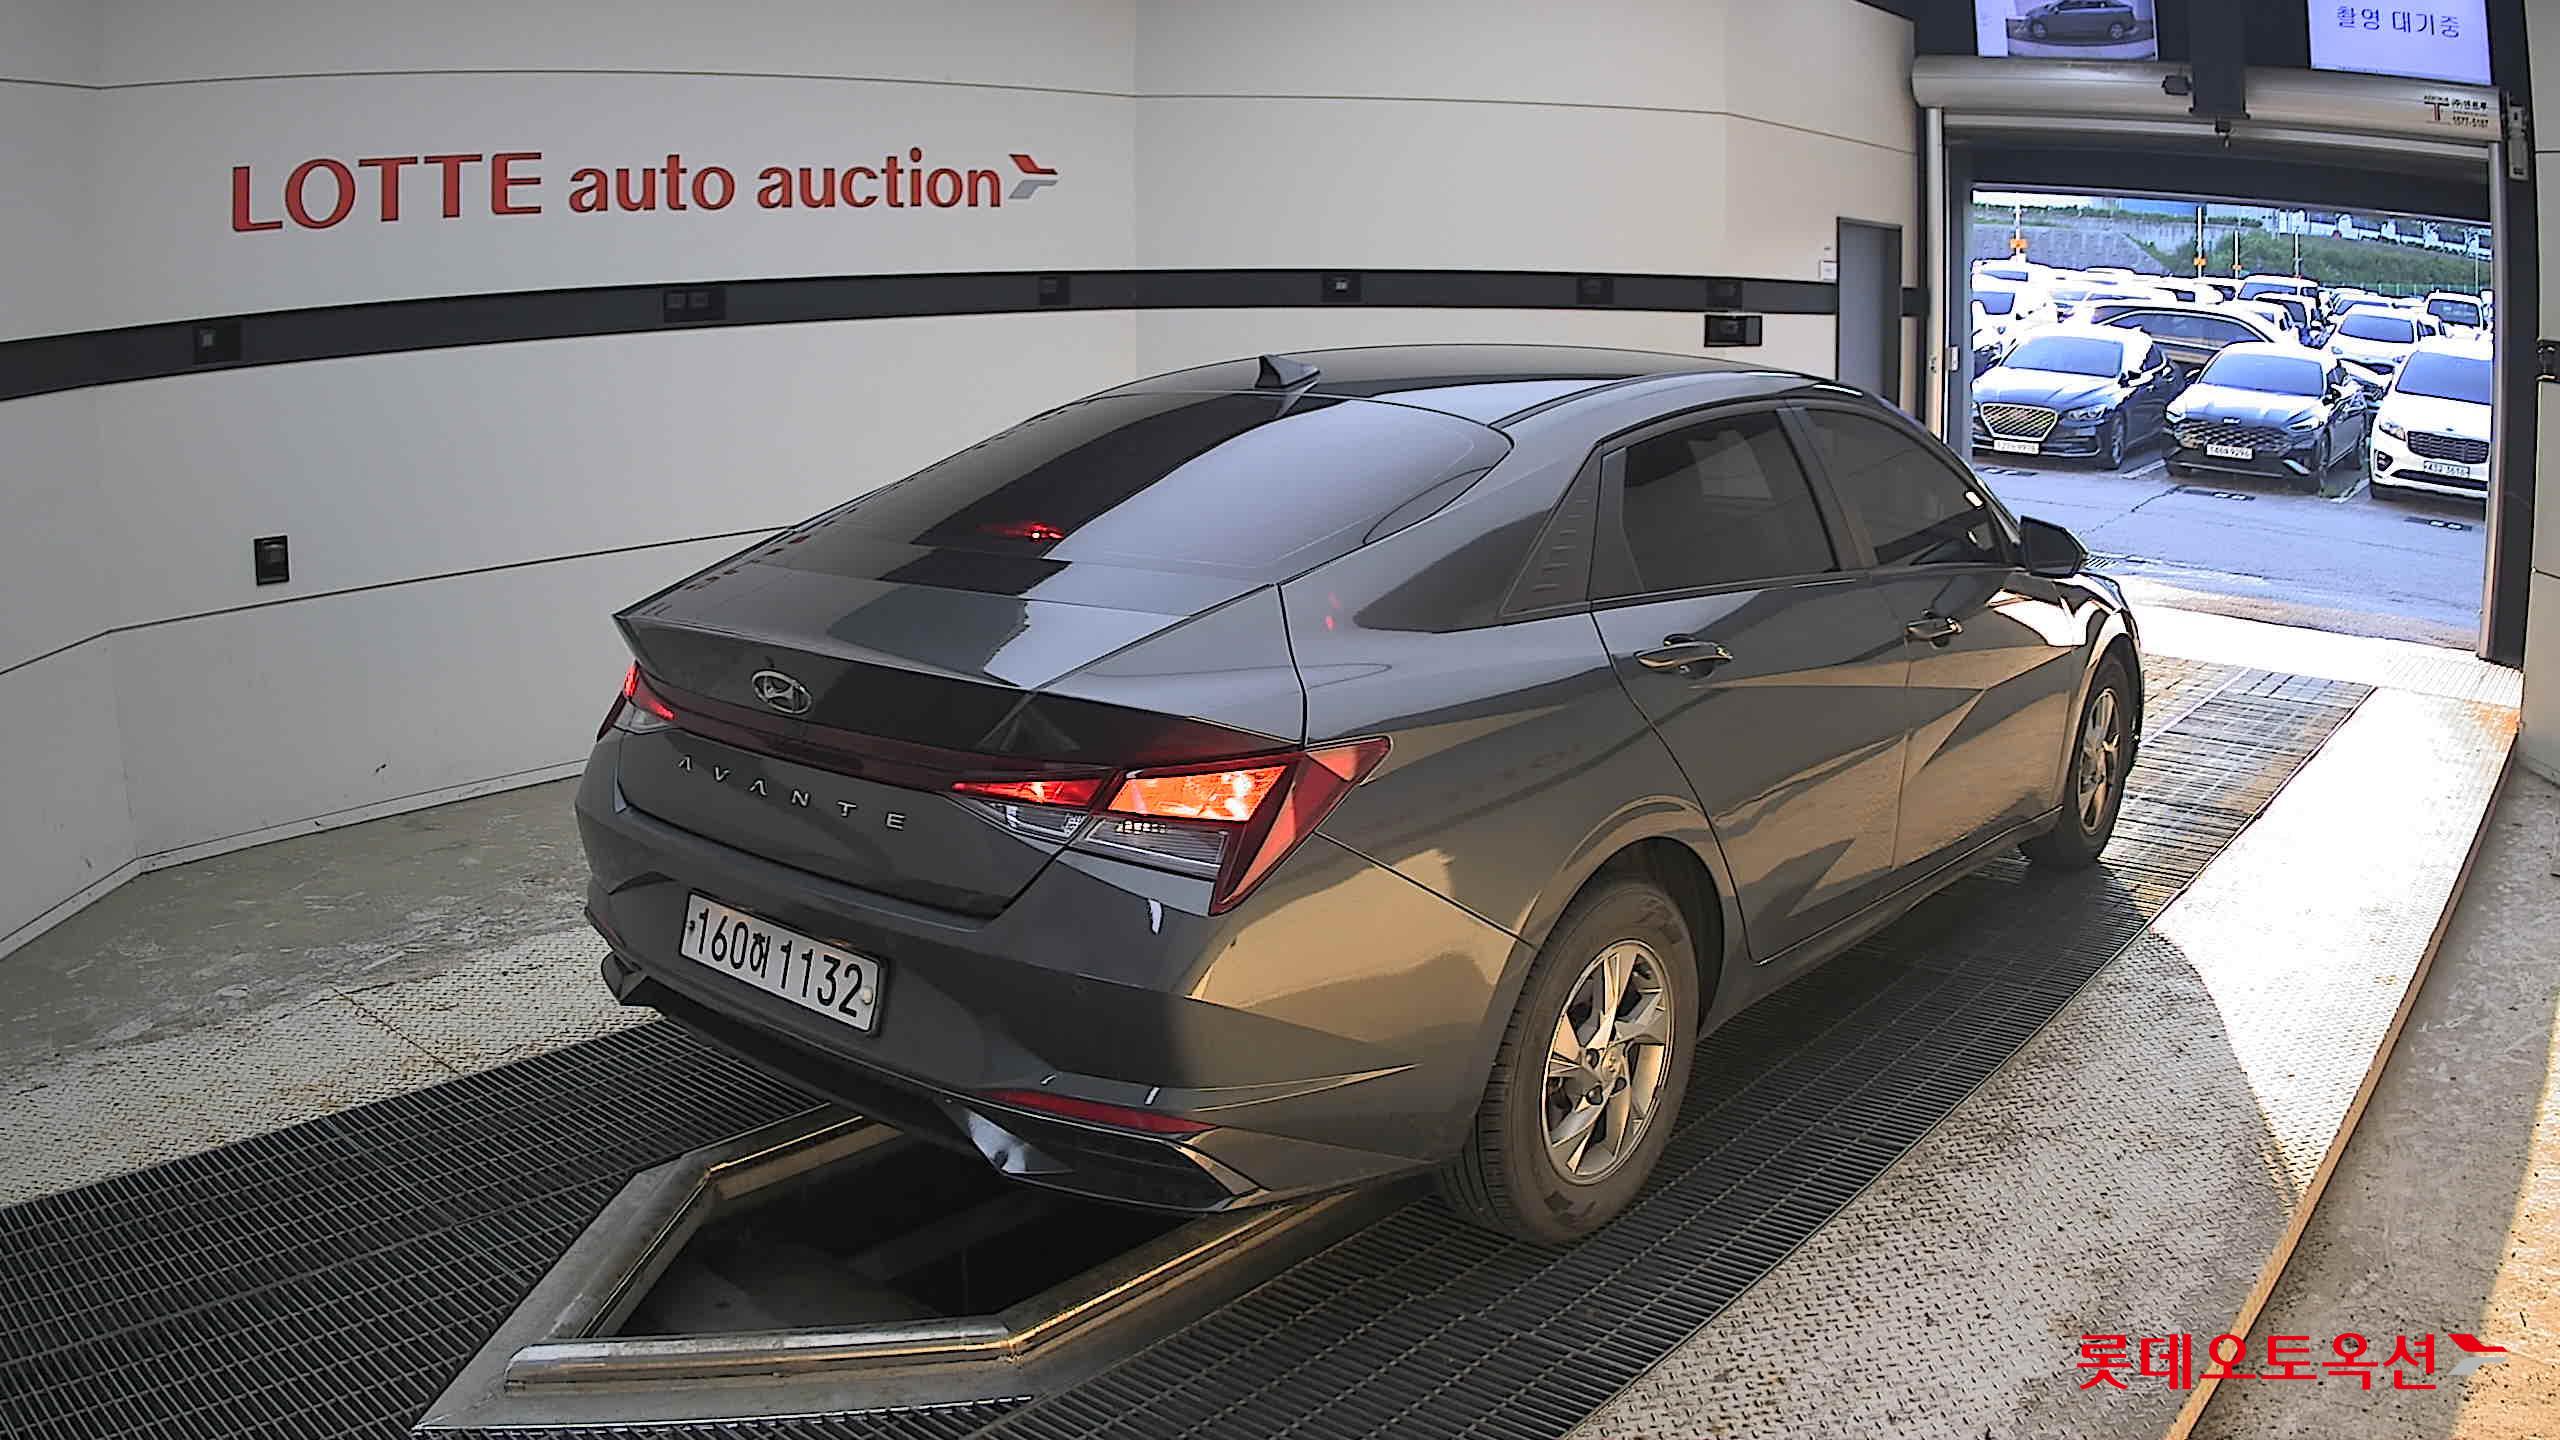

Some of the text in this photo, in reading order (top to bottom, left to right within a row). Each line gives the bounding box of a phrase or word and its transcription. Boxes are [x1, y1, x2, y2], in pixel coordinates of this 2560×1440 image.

[2336, 5, 2381, 31] 촬영
[231, 147, 1002, 233] LOTTE auto auction
[678, 756, 907, 831] AVANTE
